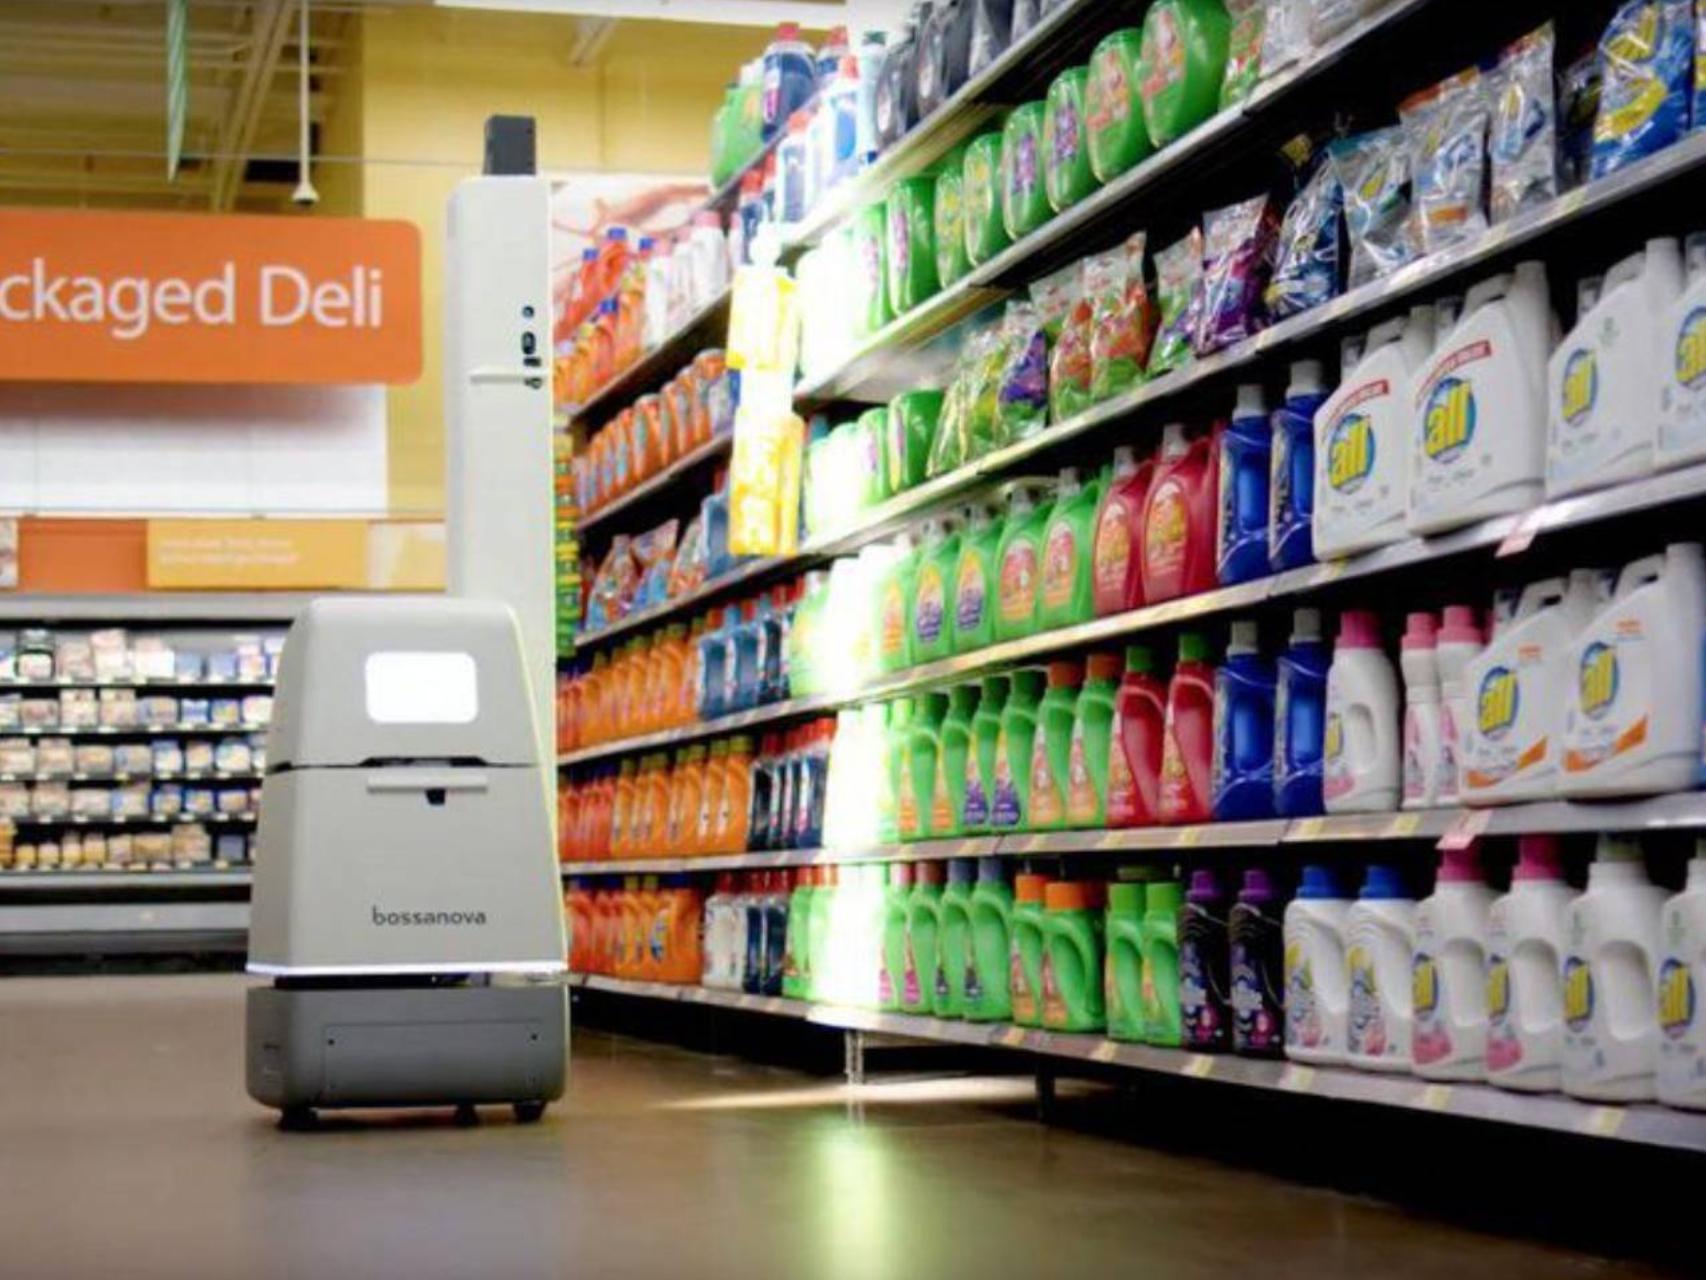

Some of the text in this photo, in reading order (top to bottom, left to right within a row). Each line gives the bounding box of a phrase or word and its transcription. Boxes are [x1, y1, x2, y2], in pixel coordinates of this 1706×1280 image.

[260, 264, 383, 328] Deli
[1330, 416, 1370, 489] all
[1425, 379, 1470, 459] all
[372, 902, 487, 926] bossanova
